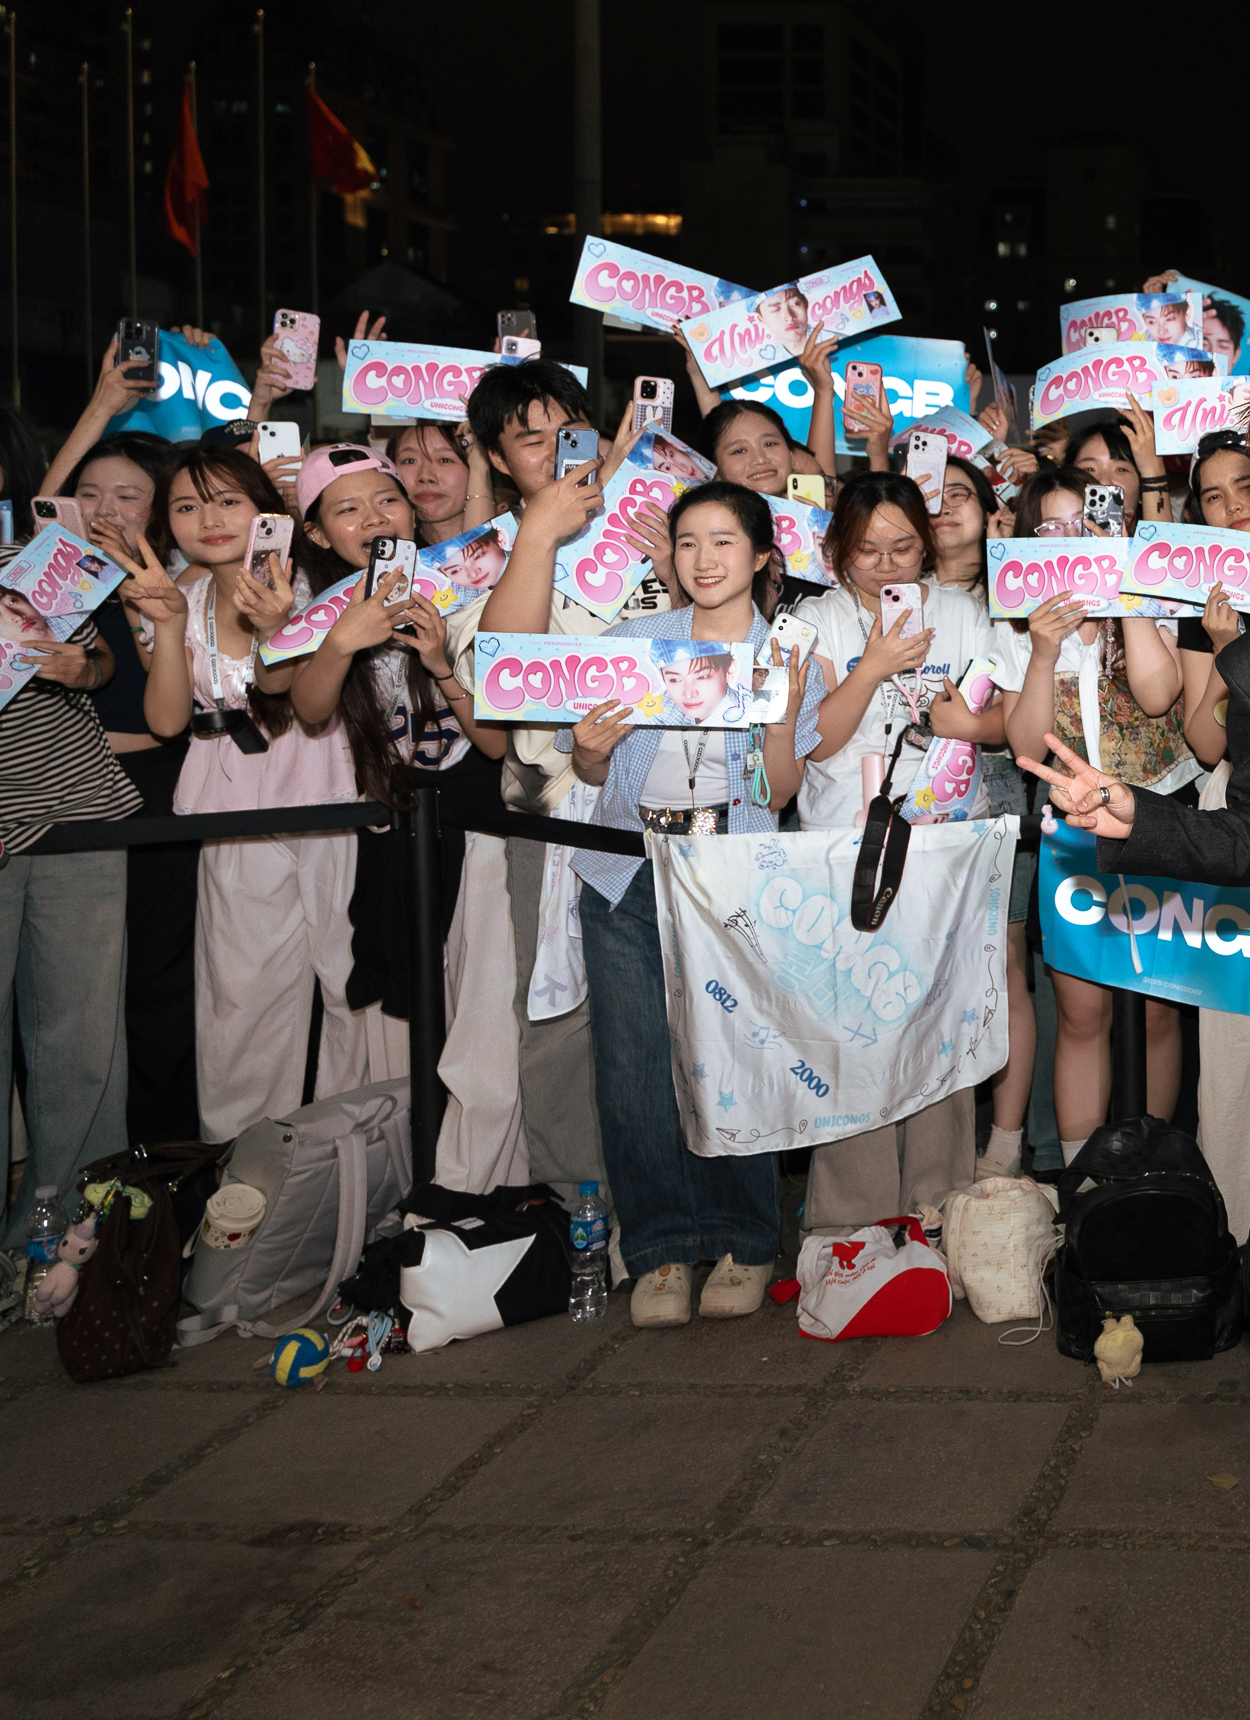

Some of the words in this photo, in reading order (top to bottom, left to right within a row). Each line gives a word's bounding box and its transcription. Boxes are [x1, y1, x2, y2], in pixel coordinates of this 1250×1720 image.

[584, 262, 711, 318] CONGB
[810, 270, 875, 322] congs
[728, 367, 954, 418] COGB
[1039, 355, 1157, 416] CONGB
[575, 478, 676, 604] CONGB
[31, 537, 83, 611] congs
[995, 555, 1122, 608] CONGB
[485, 655, 650, 710] CONGB
[871, 887, 893, 926] Canon
[987, 887, 1000, 936] UNICONGS
[704, 979, 738, 1014] 0812
[1143, 976, 1163, 987] 2025
[789, 1059, 830, 1098] 2000
[813, 1111, 871, 1129] UNICONGS
